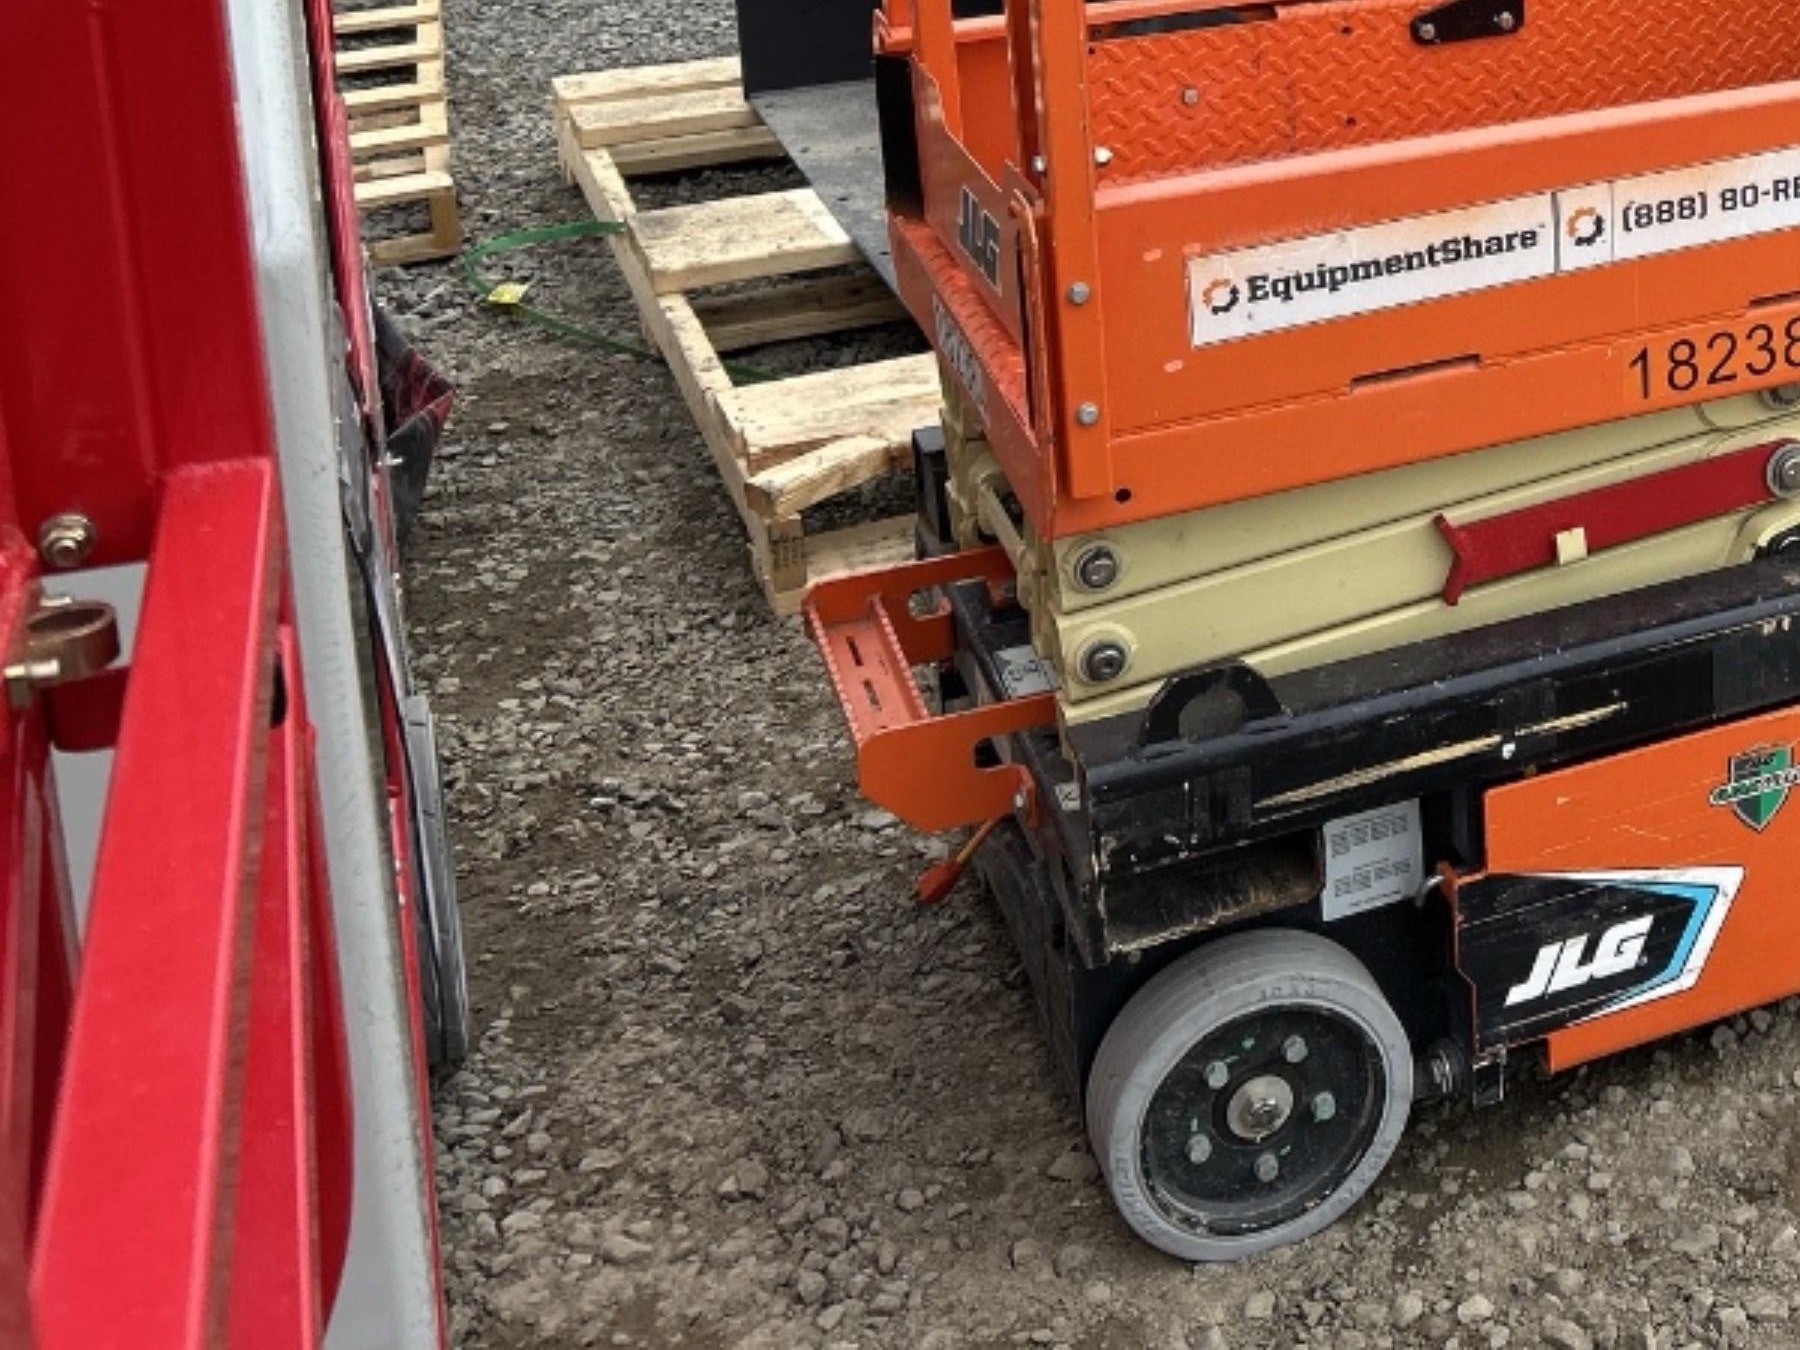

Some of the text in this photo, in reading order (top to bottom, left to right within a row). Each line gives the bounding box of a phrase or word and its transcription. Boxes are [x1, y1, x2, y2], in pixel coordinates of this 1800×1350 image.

[1621, 191, 1708, 233] (888)
[1247, 228, 1540, 302] EquipmentShare
[1503, 914, 1656, 1008] JLG
